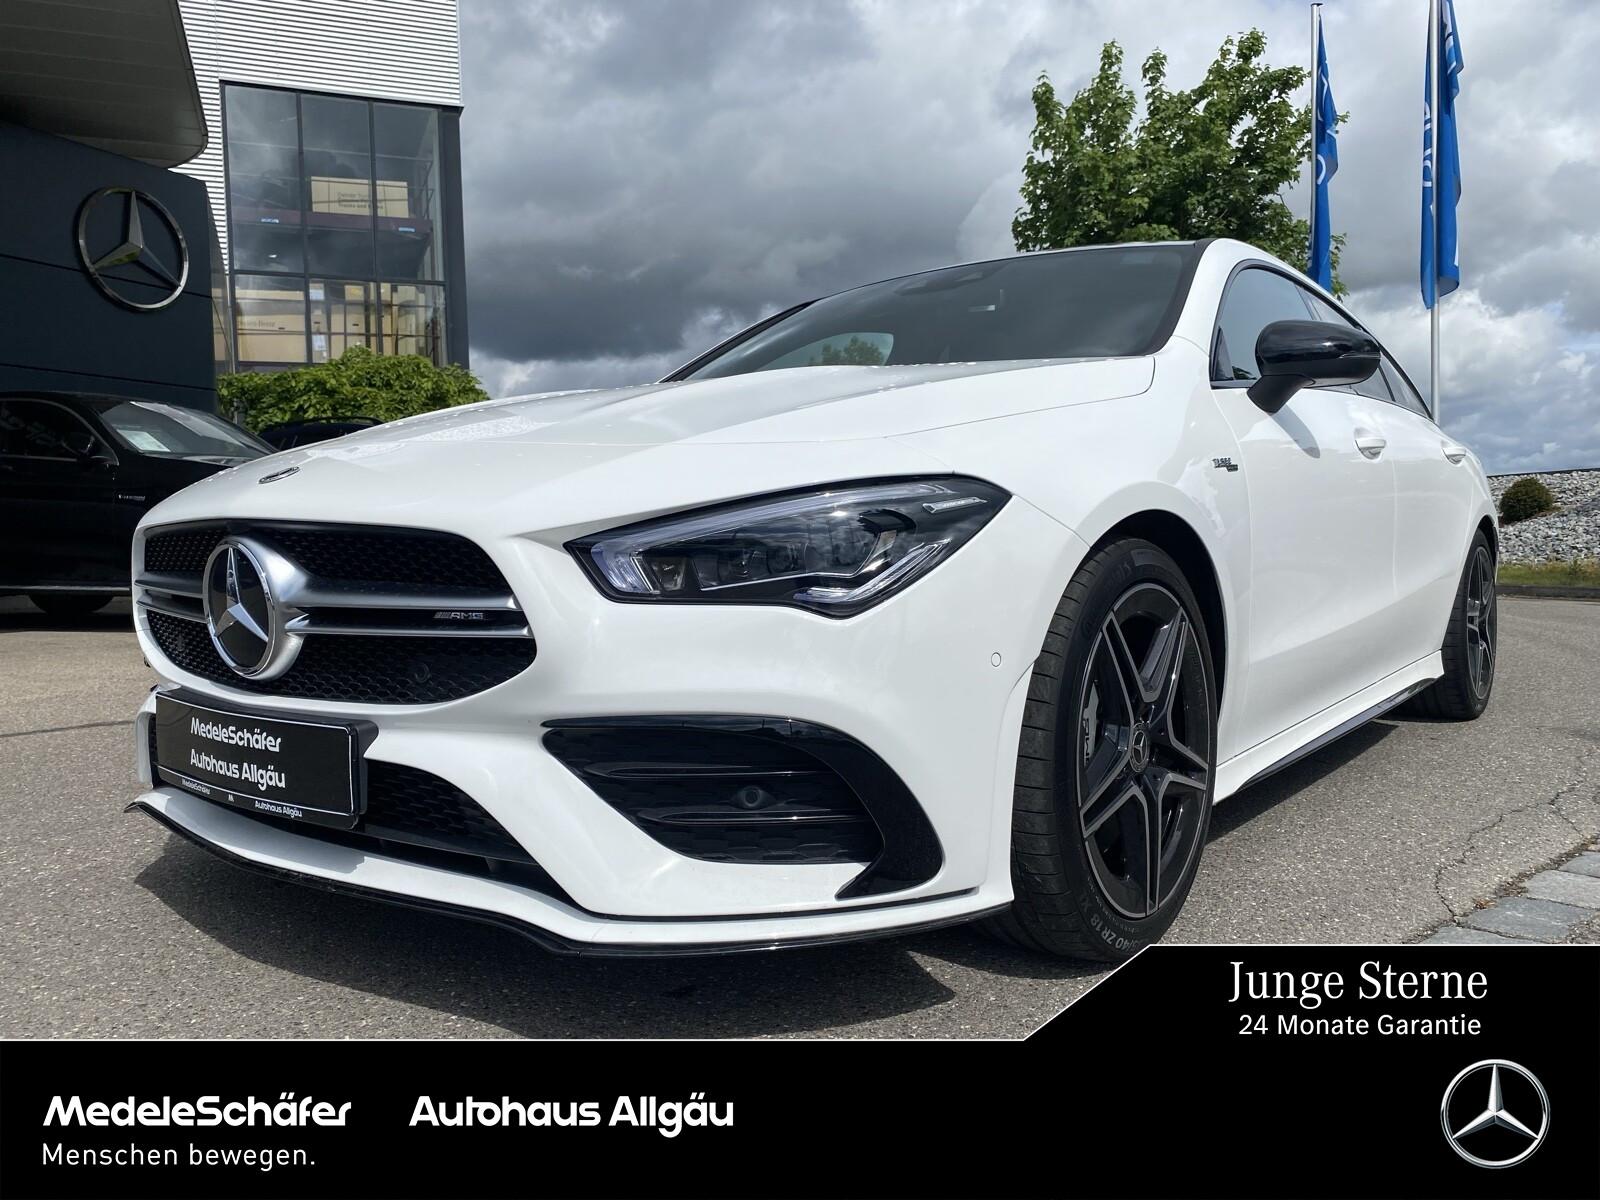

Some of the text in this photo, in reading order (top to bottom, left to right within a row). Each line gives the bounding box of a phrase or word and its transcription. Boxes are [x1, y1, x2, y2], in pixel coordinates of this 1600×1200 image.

[190, 716, 282, 752] MedeleSchäfer
[190, 748, 286, 791] Autohaus Allgäu
[255, 800, 303, 818] Autohaus Allgäu
